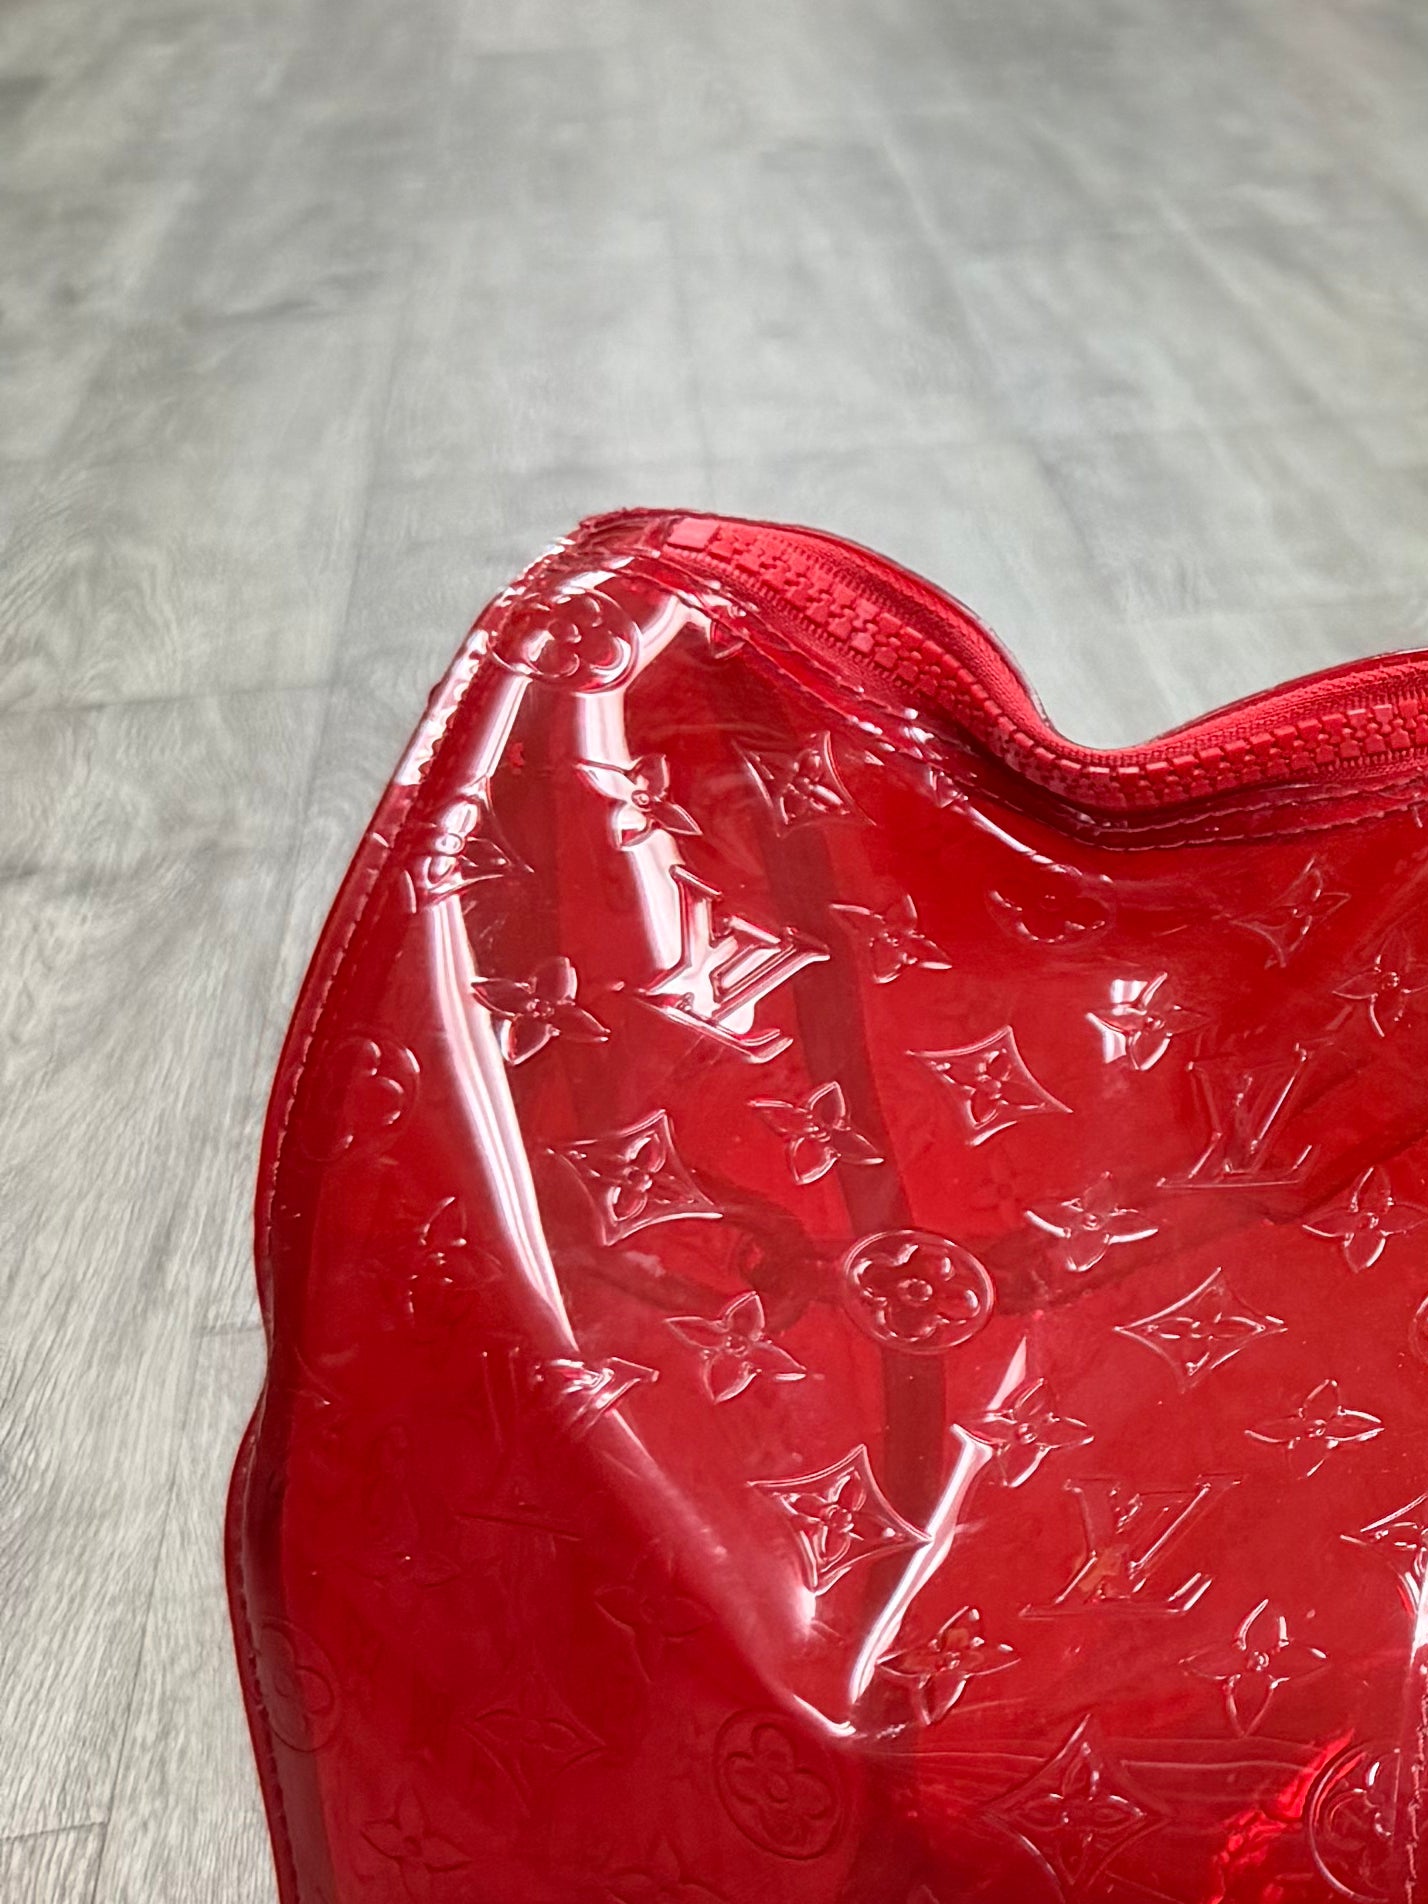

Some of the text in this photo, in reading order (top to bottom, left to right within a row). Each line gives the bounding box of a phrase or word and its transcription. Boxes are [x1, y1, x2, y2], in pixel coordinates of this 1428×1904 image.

[636, 864, 830, 1062] LV
[1157, 1042, 1335, 1188] LV
[1018, 1473, 1248, 1622] LV
